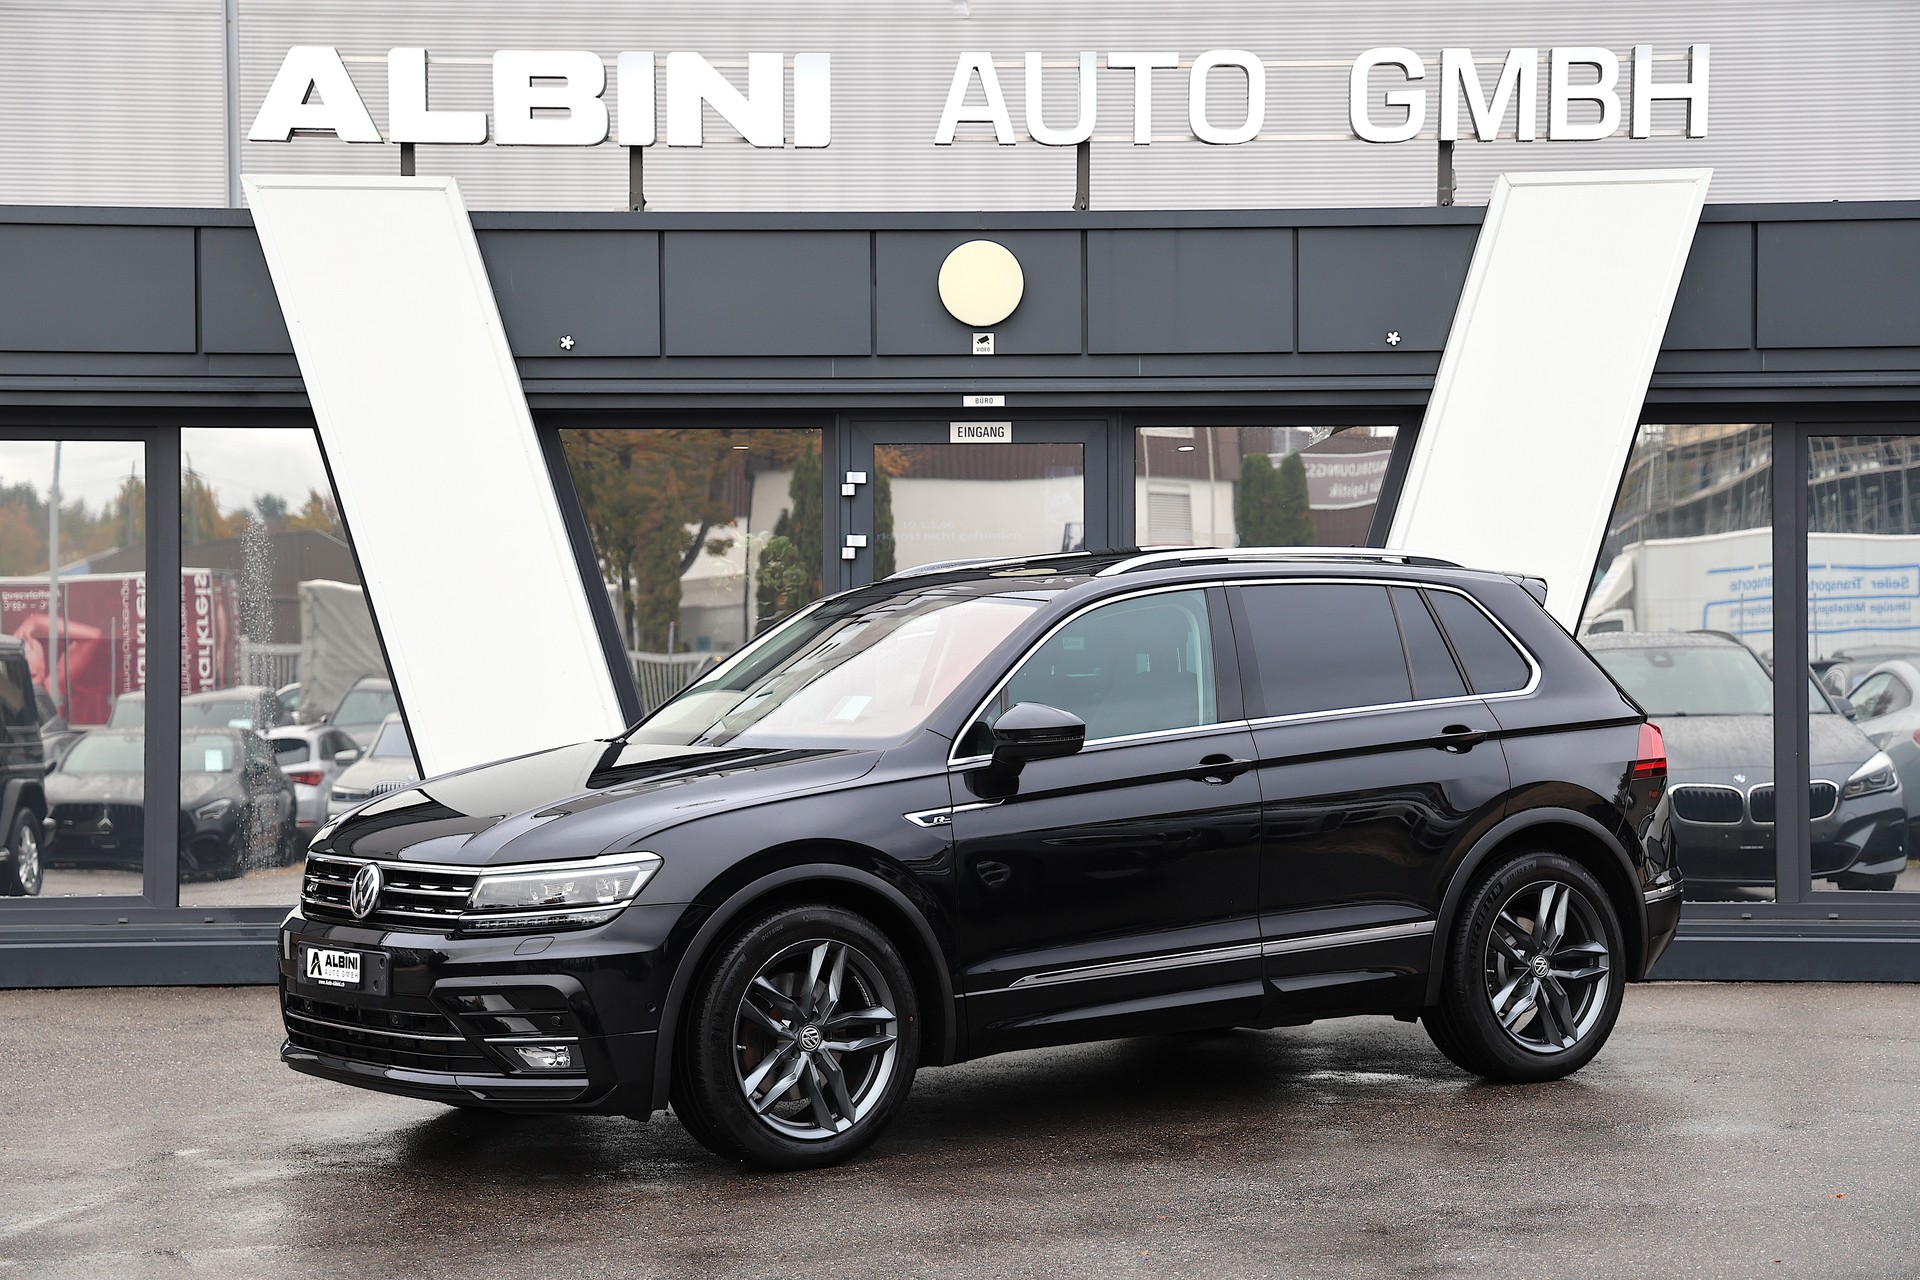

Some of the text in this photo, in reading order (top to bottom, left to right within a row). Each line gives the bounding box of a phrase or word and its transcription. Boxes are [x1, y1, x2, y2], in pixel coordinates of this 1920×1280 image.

[247, 43, 1711, 148] ALBINI AUTO GMBH
[974, 396, 994, 405] BÜRO
[957, 426, 1005, 439] EINGANG
[761, 924, 784, 941] OUTSIDE
[325, 953, 358, 970] ALBINI
